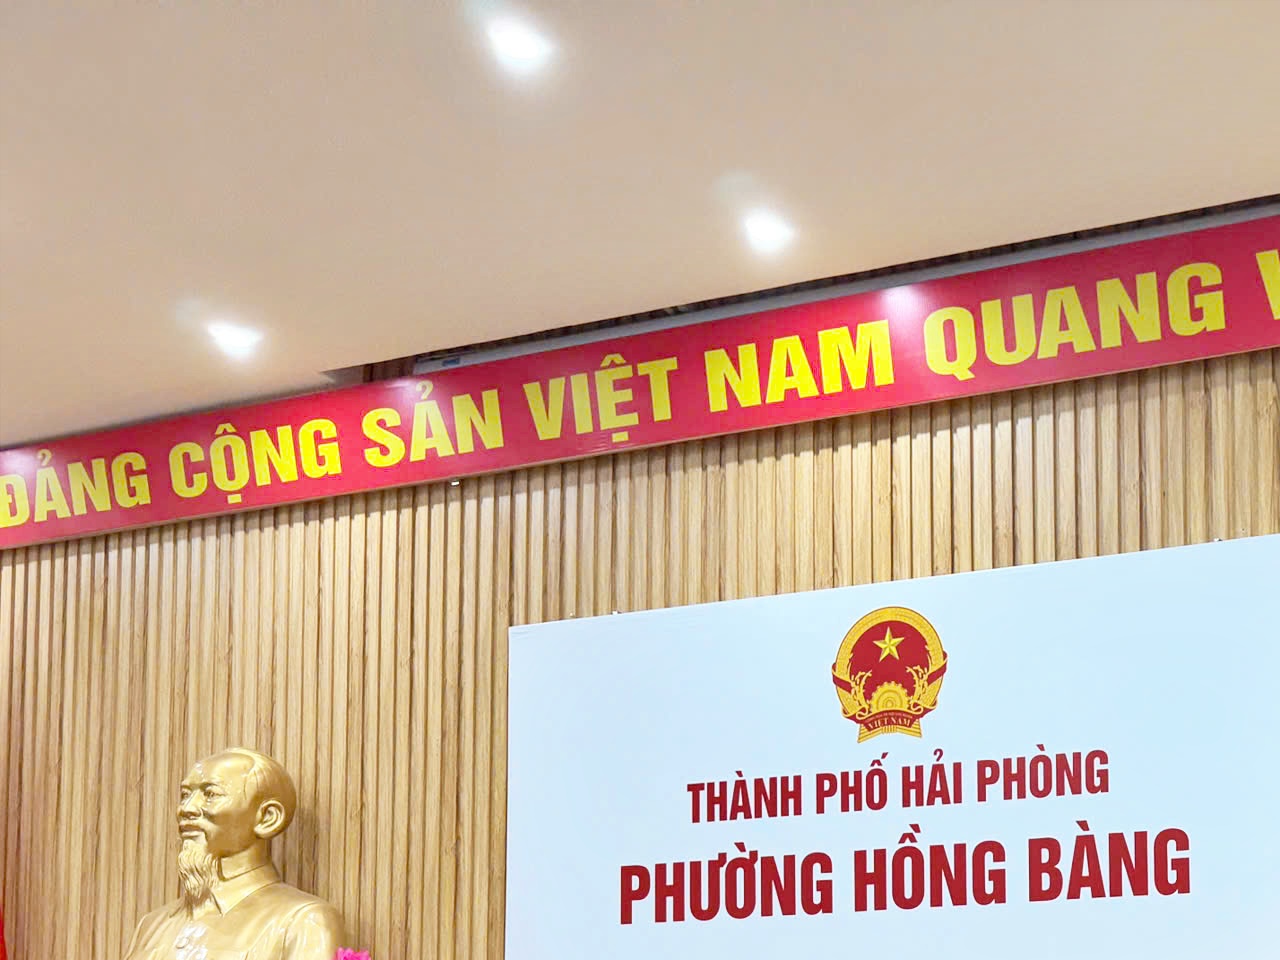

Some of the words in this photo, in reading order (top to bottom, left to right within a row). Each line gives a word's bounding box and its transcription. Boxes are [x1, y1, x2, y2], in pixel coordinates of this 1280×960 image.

[0, 449, 151, 528] ĐẢNG
[169, 418, 342, 504] CỘNG
[363, 380, 504, 468] SẢN
[524, 354, 678, 442] VIỆT
[704, 322, 895, 412] NAM
[922, 262, 1226, 381] QUANG
[687, 769, 802, 823] THÀNH
[816, 752, 889, 815] PHỐ
[901, 748, 963, 808] HẢI
[977, 744, 1109, 802] PHÒNG
[620, 842, 833, 925] PHƯỜNG
[854, 823, 1007, 912] HỒNG
[1028, 820, 1190, 903] BÀNG
